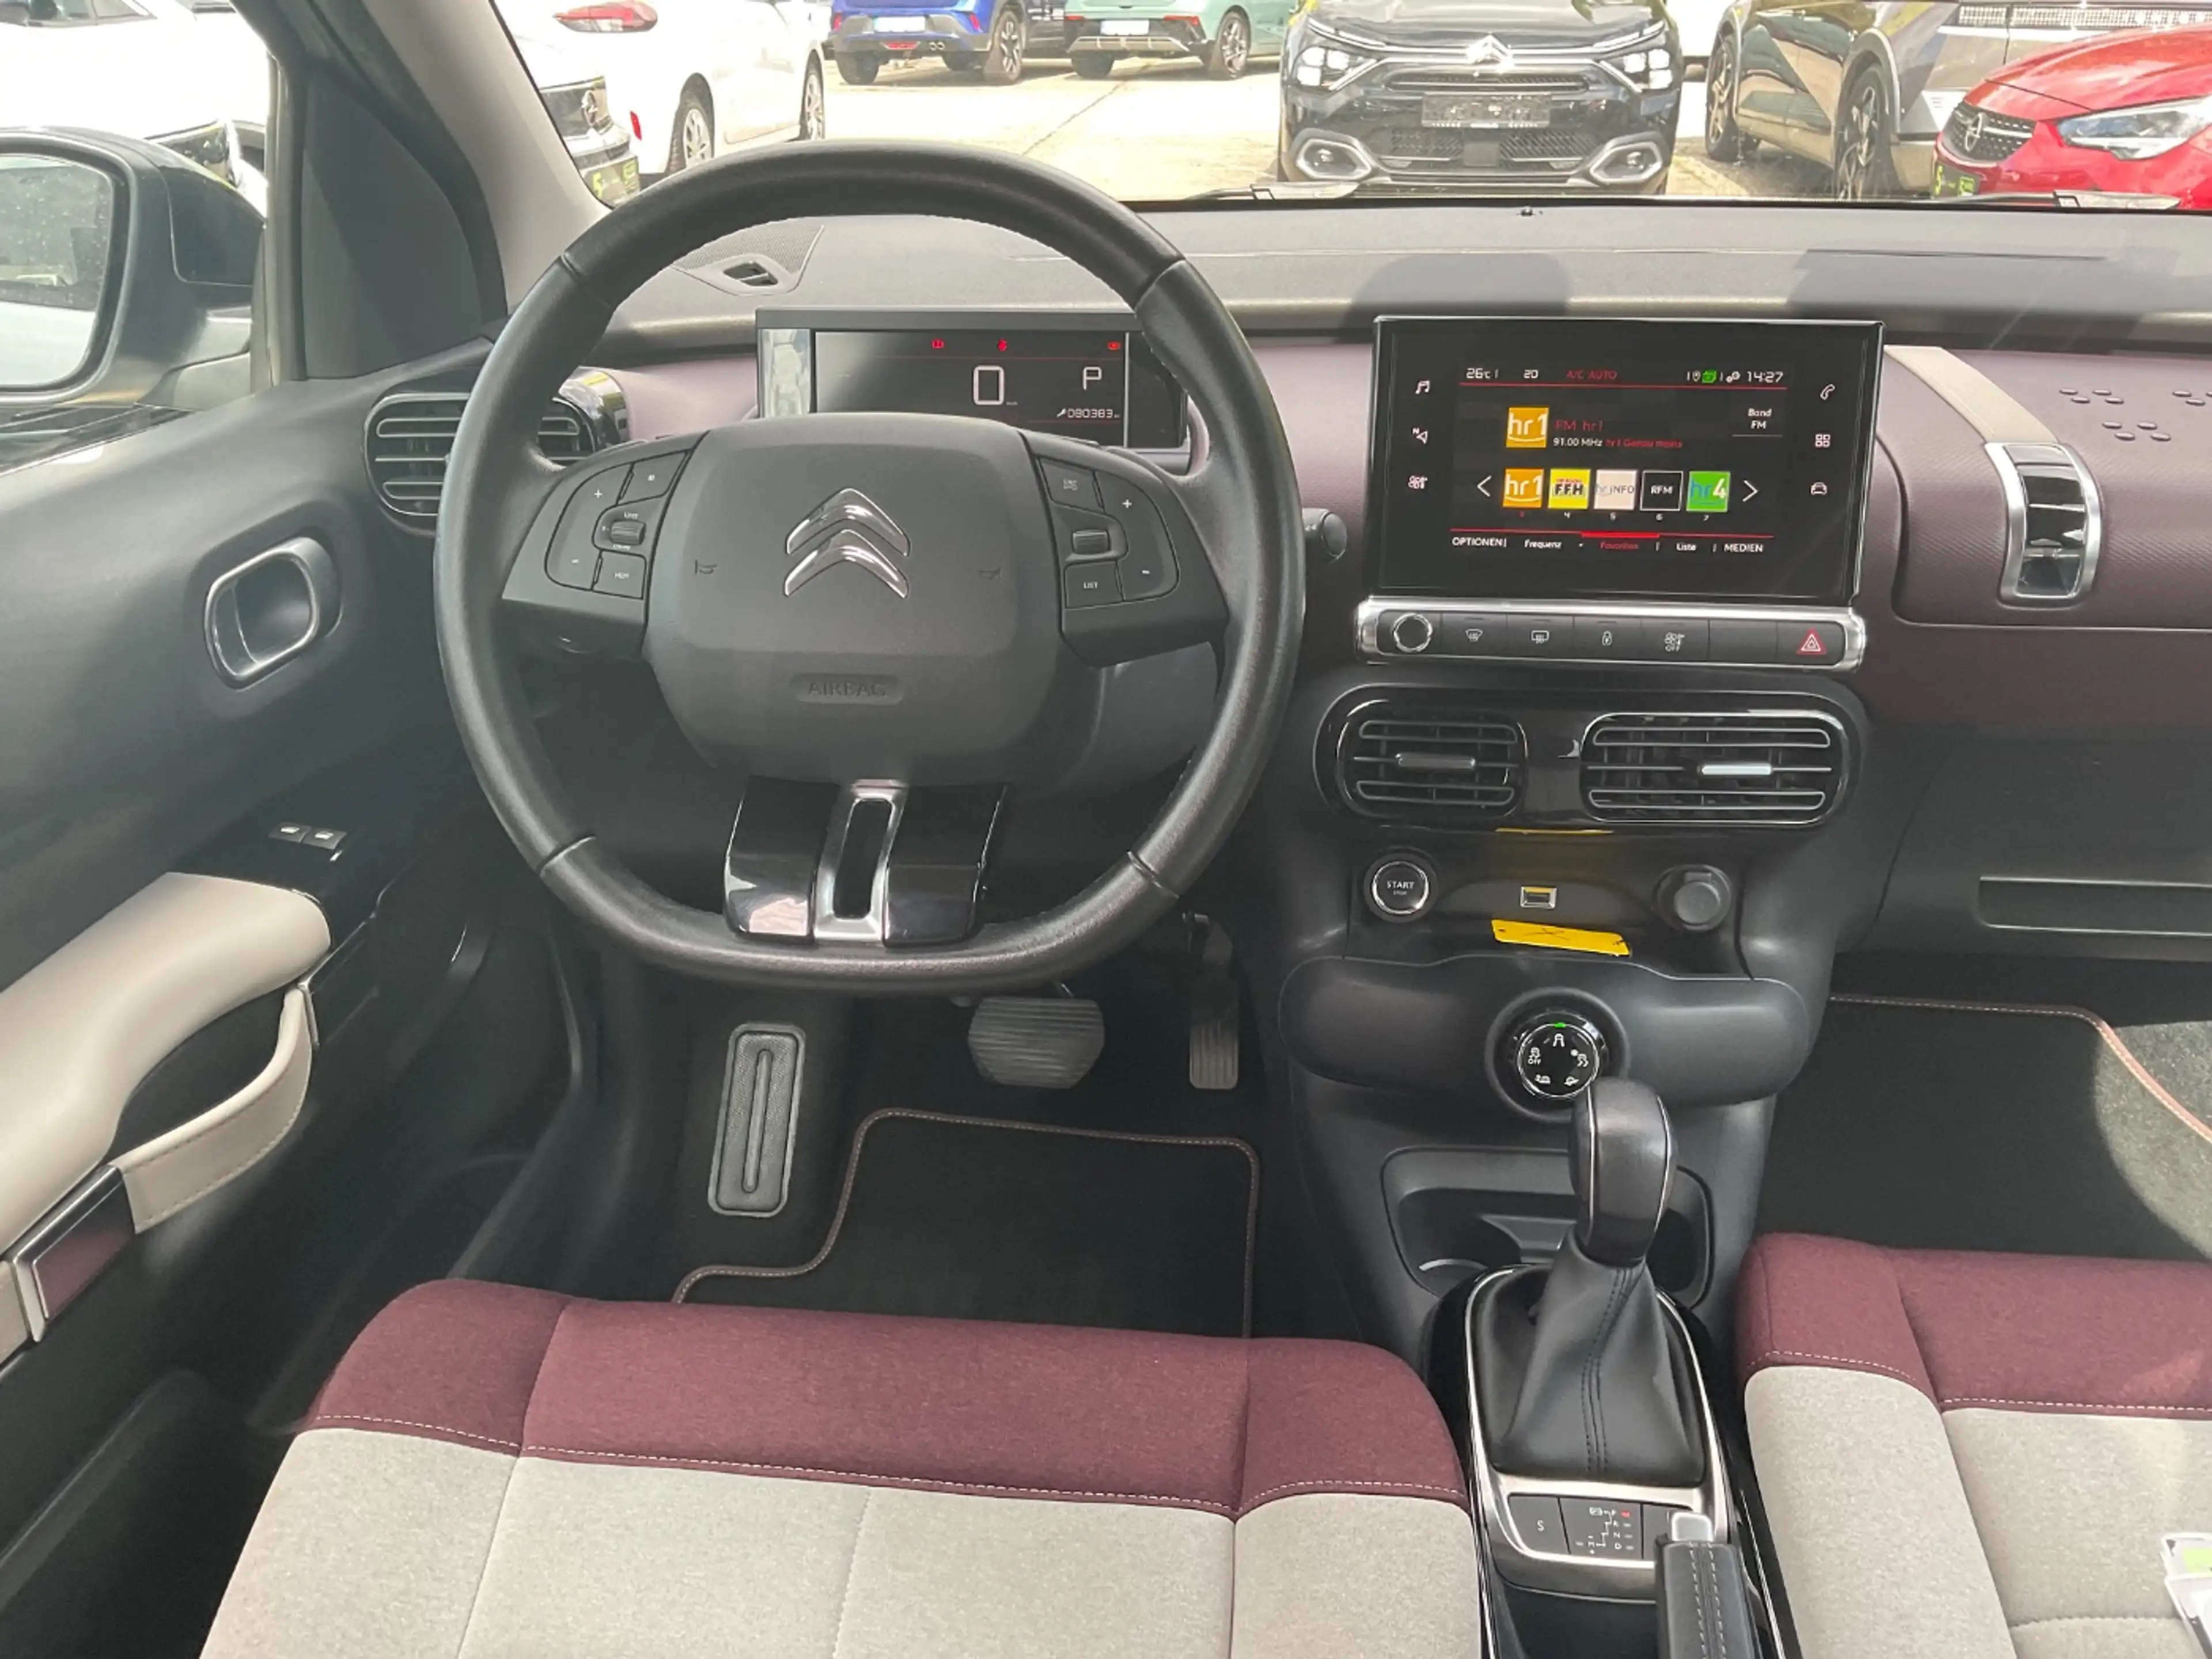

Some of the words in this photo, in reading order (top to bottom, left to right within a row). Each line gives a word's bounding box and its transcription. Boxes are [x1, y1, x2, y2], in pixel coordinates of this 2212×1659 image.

[1082, 366, 1102, 391] P
[1523, 369, 1539, 378] 20
[1566, 370, 1584, 379] A/C
[1588, 370, 1618, 380] AUTO
[1747, 371, 1783, 382] 14:27
[974, 365, 1004, 405] 0
[1748, 408, 1772, 417] Band
[1555, 420, 1576, 431] FM
[1751, 421, 1767, 430] FM
[1553, 437, 1580, 446] 91.00
[1581, 438, 1603, 447] MHz
[1555, 483, 1584, 495] FFH
[1650, 485, 1673, 495] RFM
[1690, 478, 1726, 499] hr4
[1452, 536, 1503, 547] OPTIONEN
[1524, 539, 1562, 550] Frequenz
[1676, 543, 1696, 551] Liste
[1724, 543, 1763, 553] MEDIEN
[1083, 581, 1098, 589] LIST
[808, 680, 887, 697] AIRBAG
[1387, 880, 1415, 889] START
[1537, 1520, 1545, 1532] S
